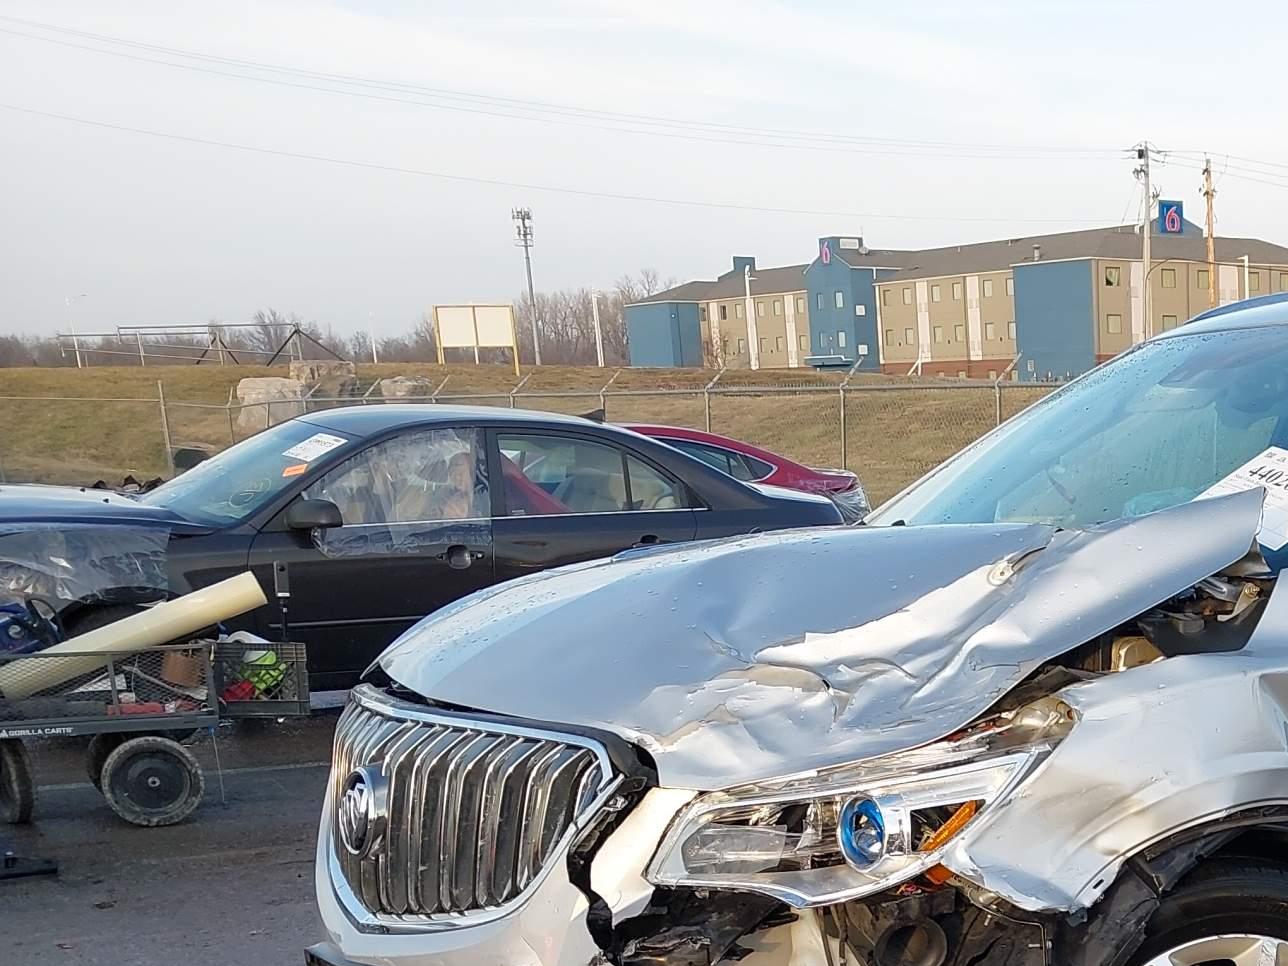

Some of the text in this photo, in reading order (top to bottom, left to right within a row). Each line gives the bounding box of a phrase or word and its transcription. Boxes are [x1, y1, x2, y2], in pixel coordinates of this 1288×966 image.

[1165, 206, 1181, 232] 6
[8, 727, 74, 737] GORILLA CARTS
